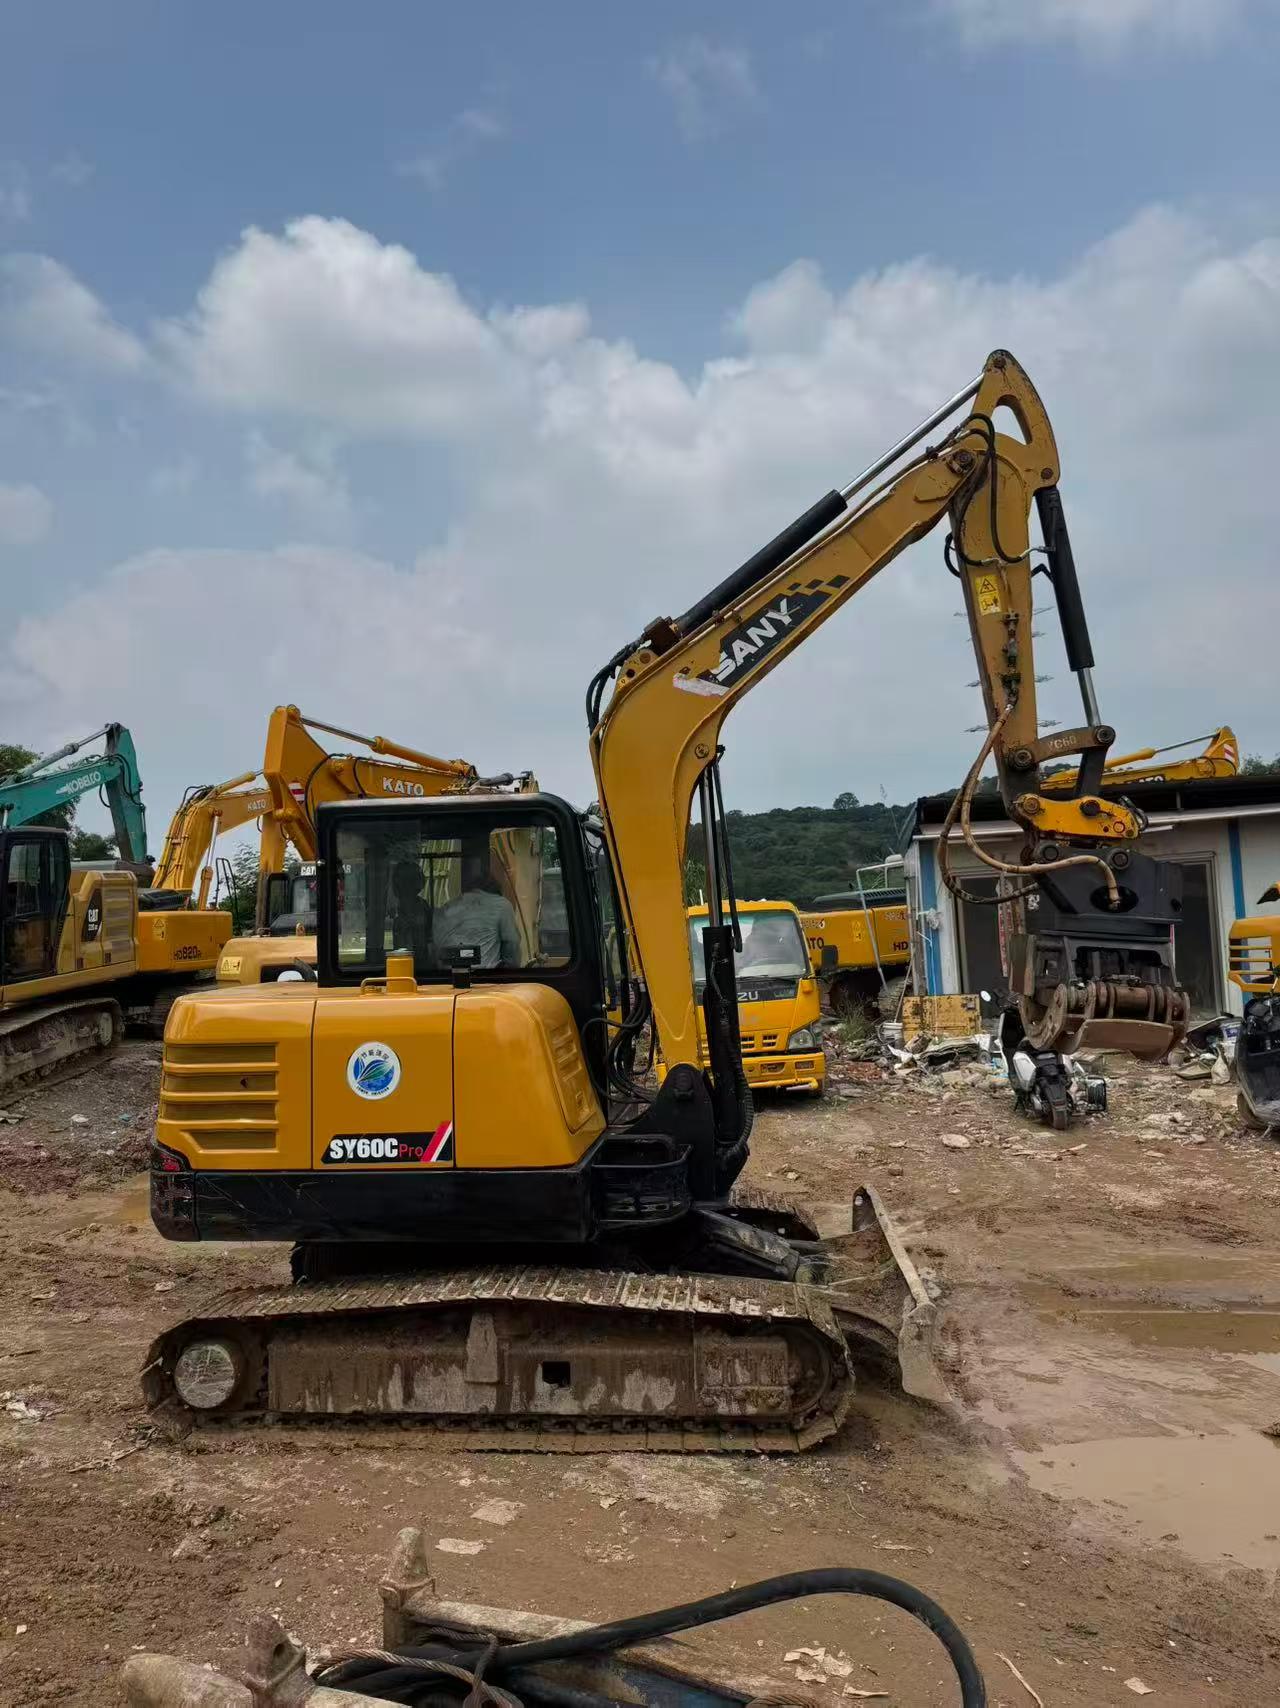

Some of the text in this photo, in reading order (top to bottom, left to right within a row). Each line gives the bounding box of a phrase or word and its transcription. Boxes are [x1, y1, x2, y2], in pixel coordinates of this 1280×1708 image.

[711, 598, 793, 682] SANY
[65, 771, 101, 794] KOBELCO
[382, 776, 424, 796] KATO
[247, 798, 266, 811] KATO
[88, 909, 99, 922] CAT
[893, 941, 909, 951] HD
[736, 991, 759, 1001] ZU
[329, 1138, 423, 1159] SY60C Pro
